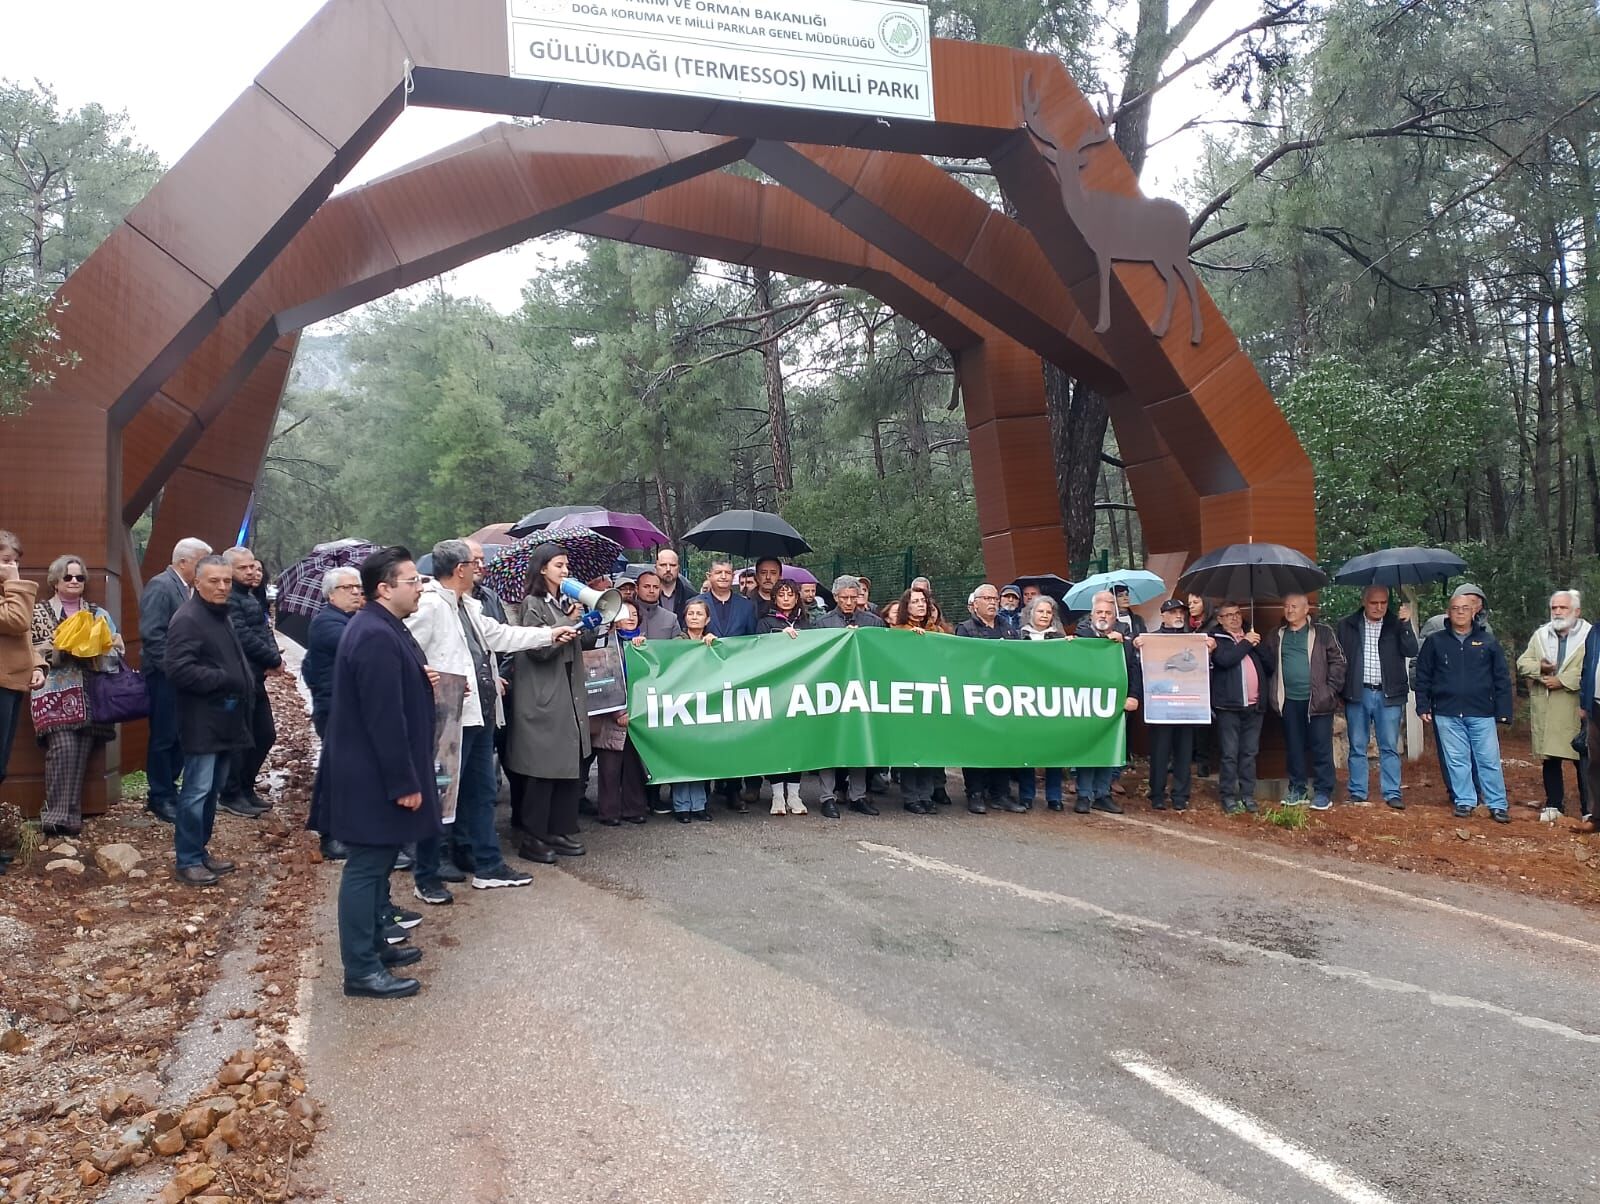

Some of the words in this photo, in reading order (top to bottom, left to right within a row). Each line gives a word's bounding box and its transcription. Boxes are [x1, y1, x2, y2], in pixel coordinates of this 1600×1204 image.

[572, 3, 608, 17] DOĞA
[611, 8, 665, 24] KORUMA
[667, 15, 682, 26] VE
[684, 16, 715, 30] MİLLİ
[717, 22, 766, 37] PARKLAR
[768, 28, 803, 41] GENEL
[805, 31, 876, 49] MÜDÜRLÜĞÜ
[673, 0, 692, 10] VE
[695, 1, 751, 18] ORMAN
[754, 9, 827, 28] BAKANLIĞI
[529, 38, 667, 72] GÜLLÜKDAĞI
[674, 55, 807, 92] (TERMESSOS)
[811, 70, 862, 95] MİLLİ
[867, 79, 920, 101] PARKI
[645, 680, 773, 729] İKLİM
[785, 676, 952, 718] ADALETİ
[962, 684, 1118, 718] FORUMU
